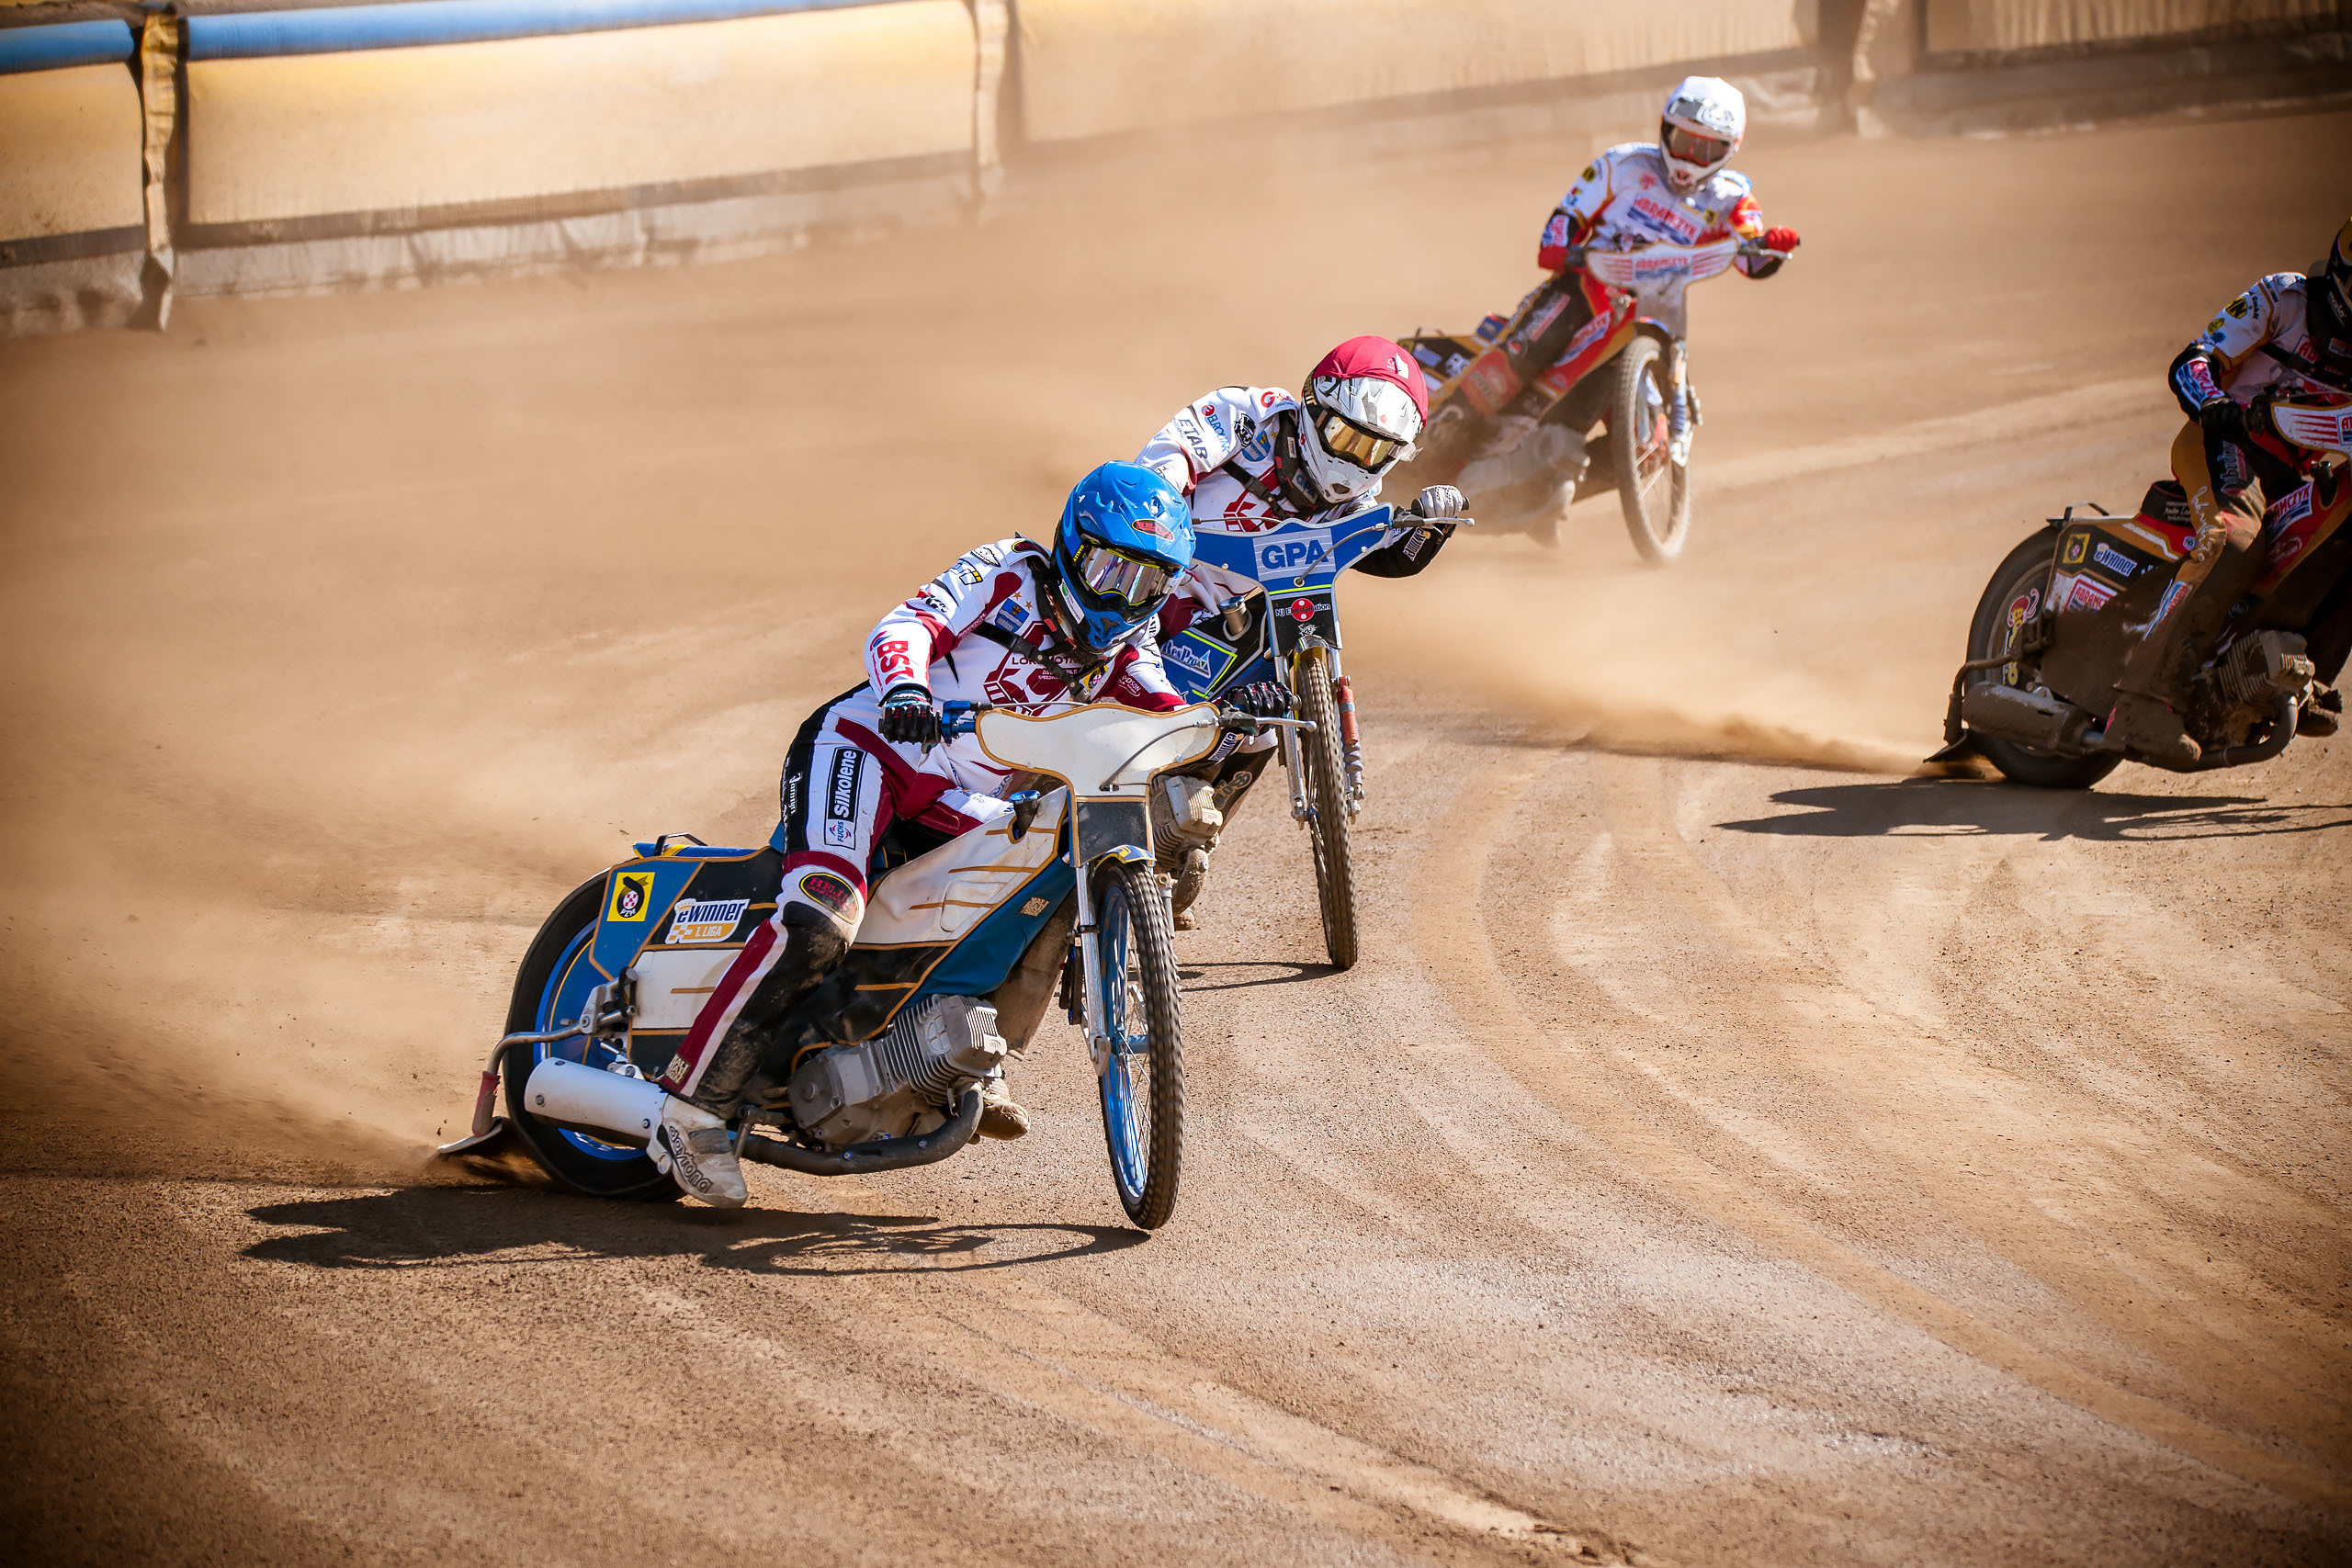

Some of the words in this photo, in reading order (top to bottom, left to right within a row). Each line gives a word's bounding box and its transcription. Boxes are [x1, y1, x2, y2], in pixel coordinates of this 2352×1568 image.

[1261, 540, 1330, 570] GPA
[834, 750, 857, 818] Silkolene
[837, 821, 845, 842] FUCHS
[620, 908, 636, 918] PZM
[702, 926, 722, 937] LIGA
